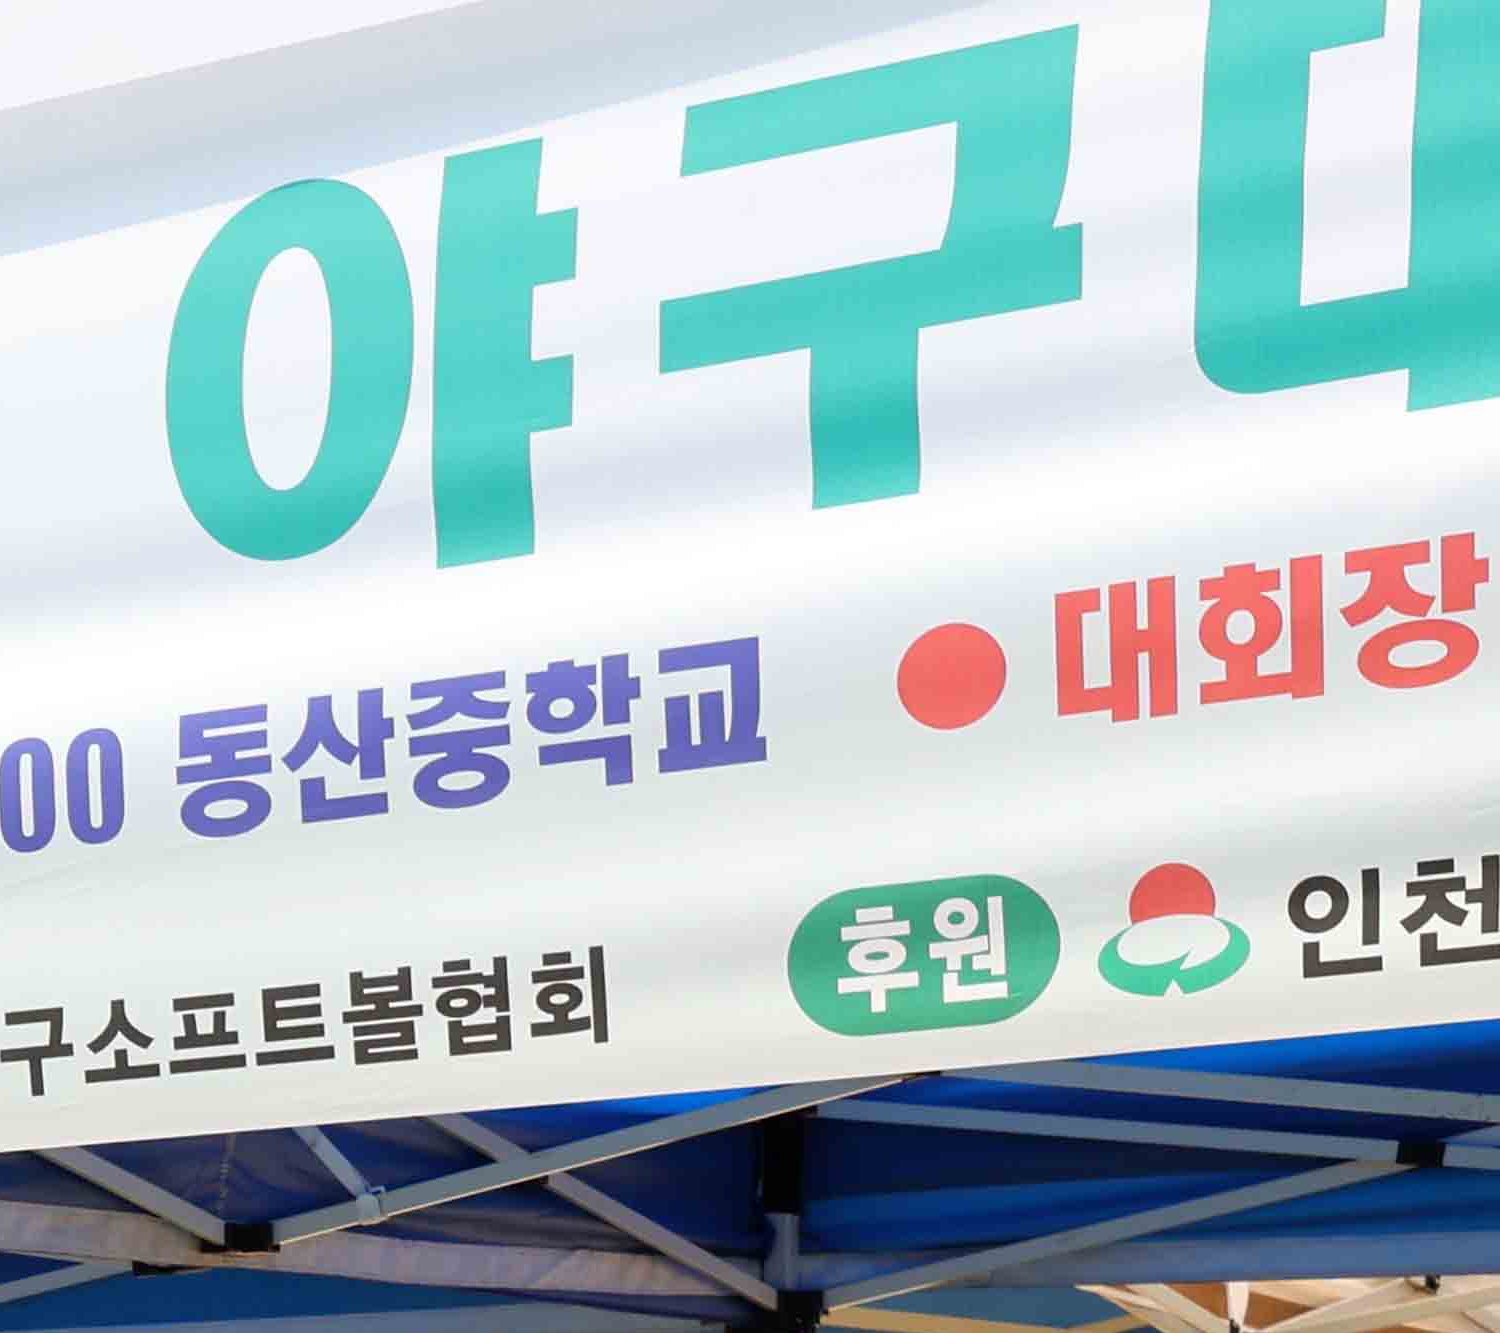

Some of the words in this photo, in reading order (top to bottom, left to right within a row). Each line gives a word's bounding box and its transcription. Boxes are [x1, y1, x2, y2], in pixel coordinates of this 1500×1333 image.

[176, 636, 768, 838] 동산중학교
[1054, 531, 1491, 724] 대회장
[836, 894, 1011, 1014] 후원
